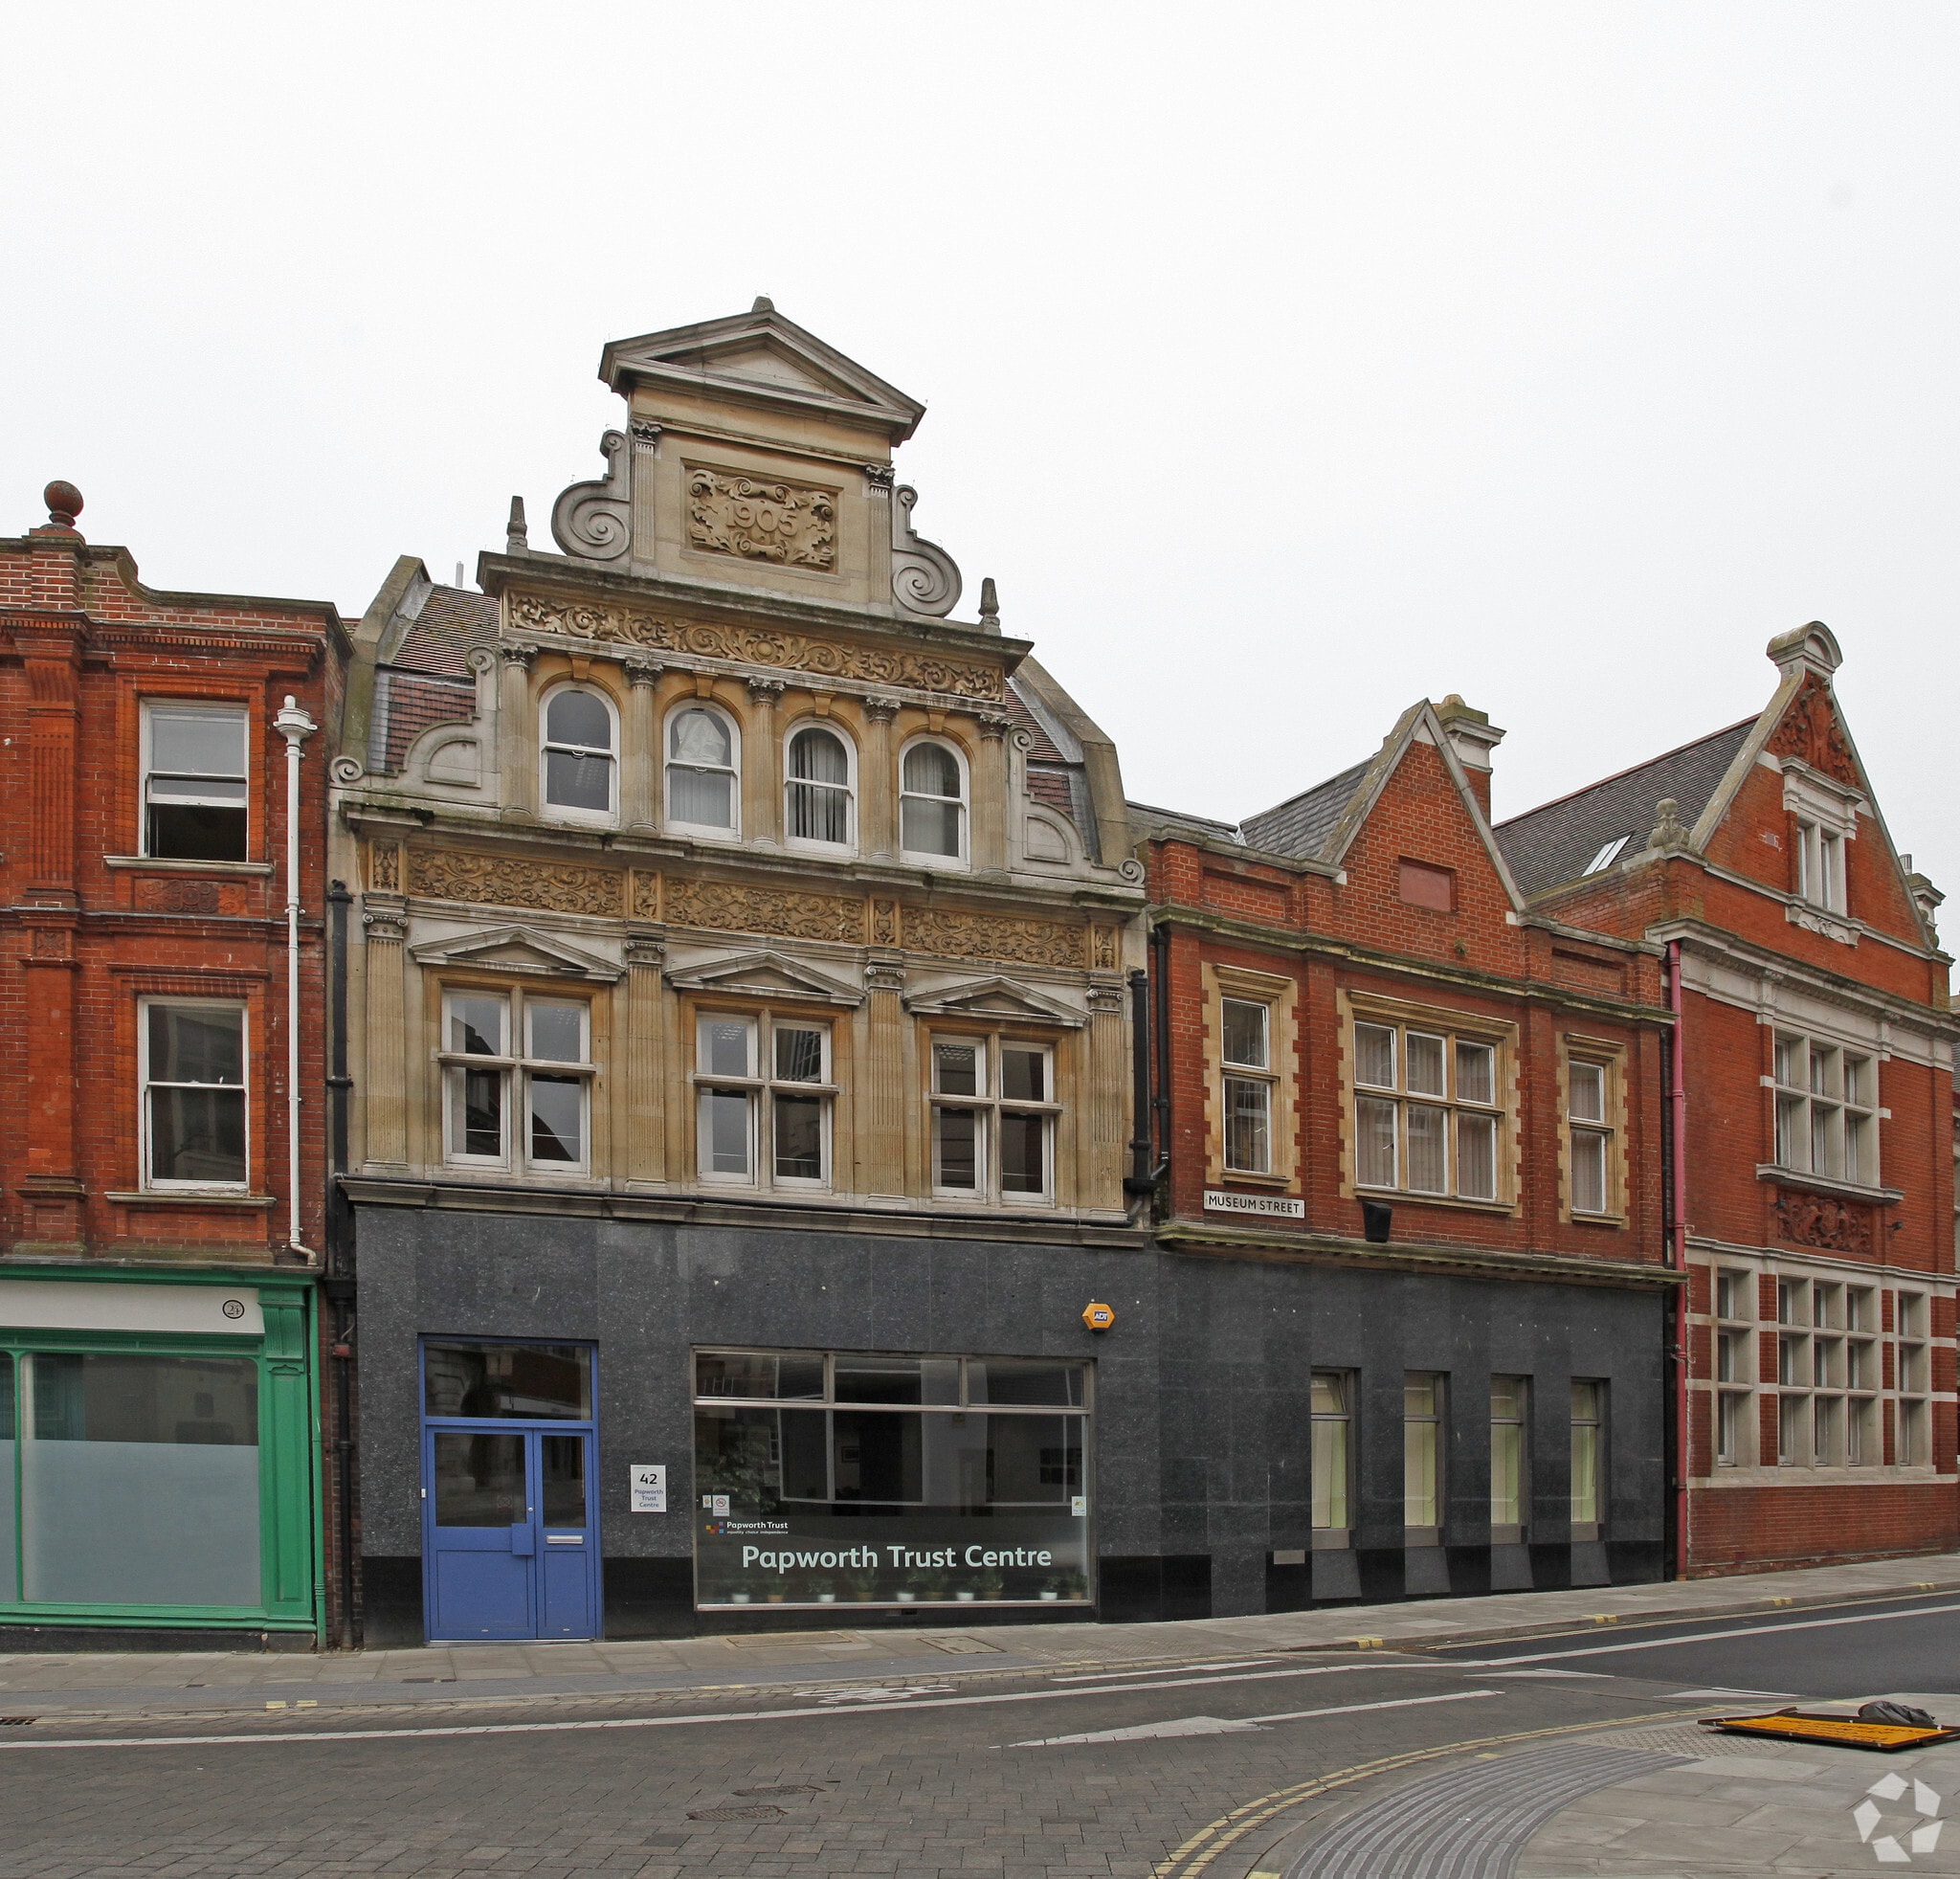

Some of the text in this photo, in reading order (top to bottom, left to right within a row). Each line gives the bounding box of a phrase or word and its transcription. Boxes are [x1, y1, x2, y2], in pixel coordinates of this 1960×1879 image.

[724, 501, 798, 536] 1905
[1208, 1195, 1300, 1214] MUSEUM STREET
[639, 1473, 657, 1485] 42
[726, 1521, 767, 1531] Papworth
[742, 1545, 1052, 1575] Papworth Trust Centre
